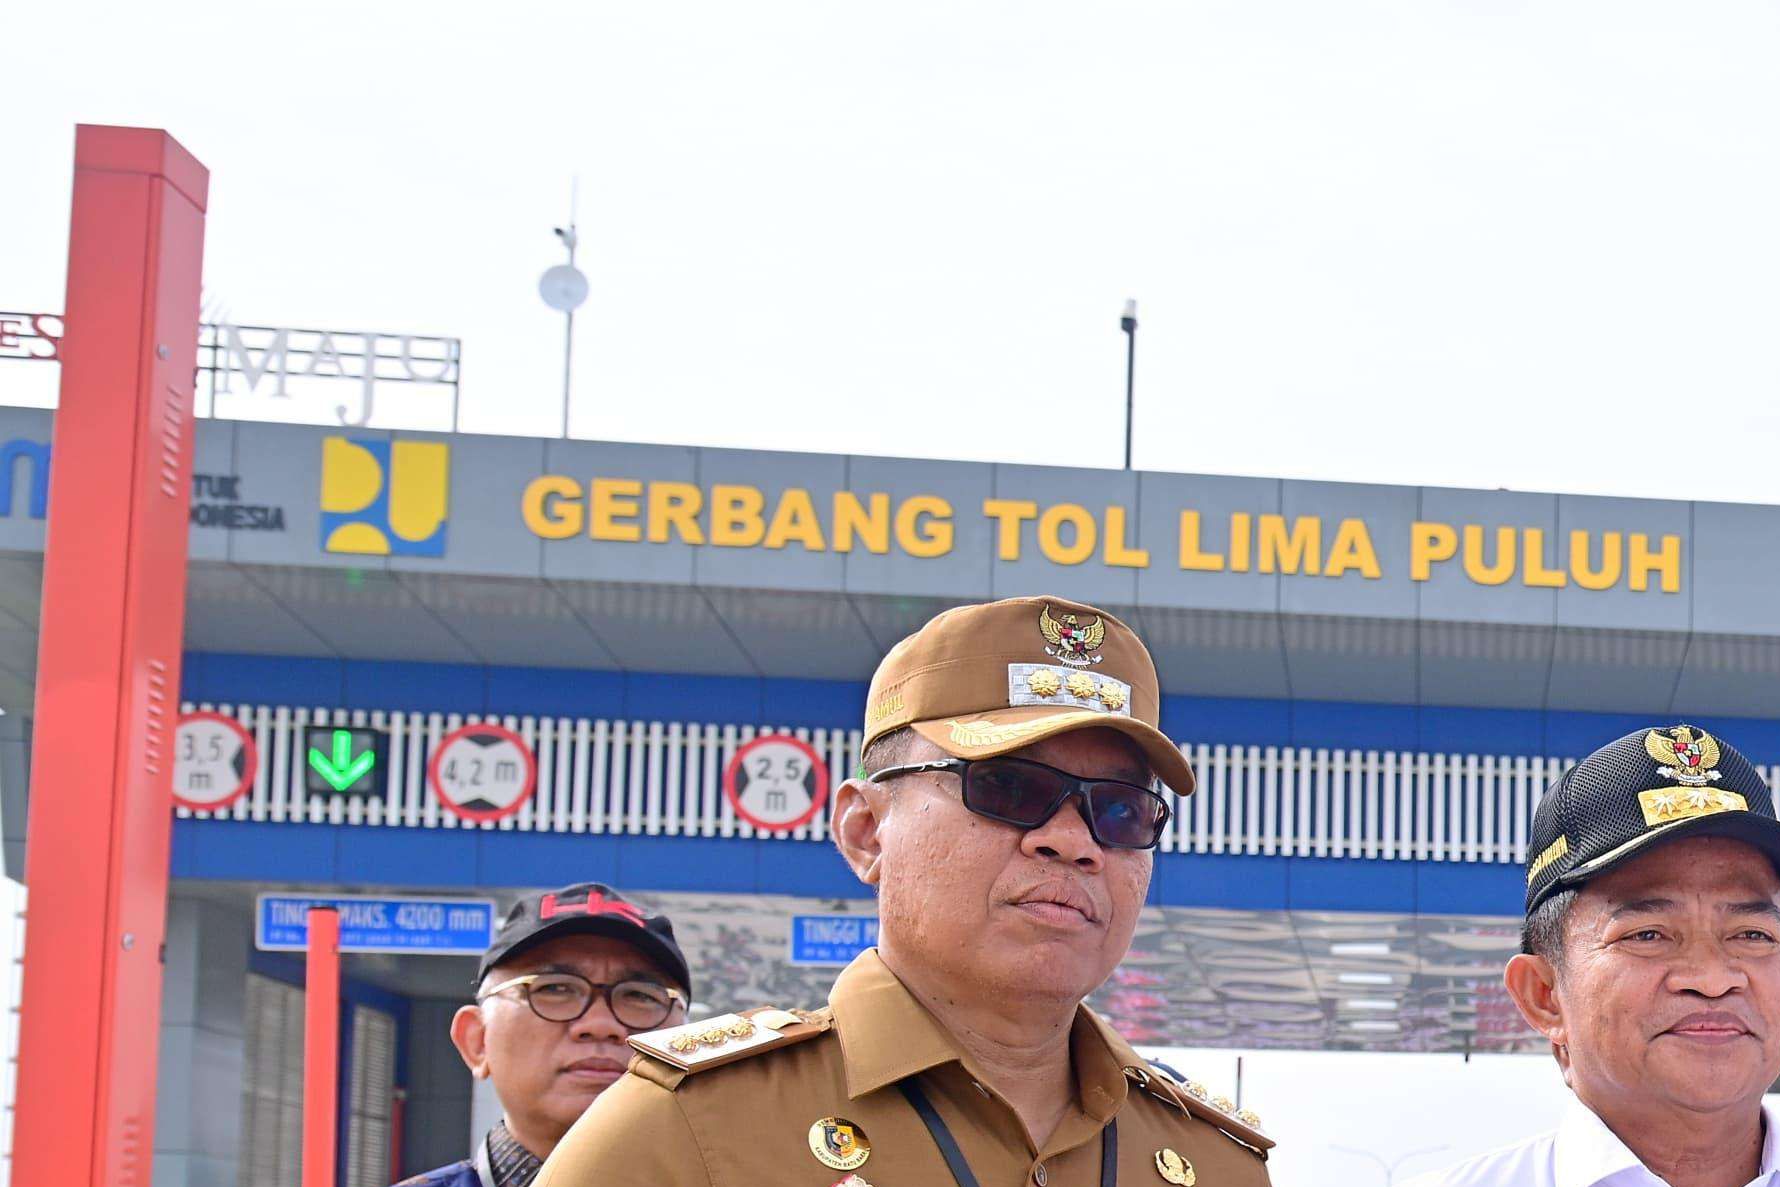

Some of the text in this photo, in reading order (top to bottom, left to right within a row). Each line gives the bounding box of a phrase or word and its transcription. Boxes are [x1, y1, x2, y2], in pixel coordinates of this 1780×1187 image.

[522, 475, 1682, 594] GERBANG TOL LIMA PULUH
[444, 758, 483, 788] 4,2
[757, 757, 801, 784] 2,5
[396, 905, 446, 931] 4200
[451, 909, 484, 931] mm
